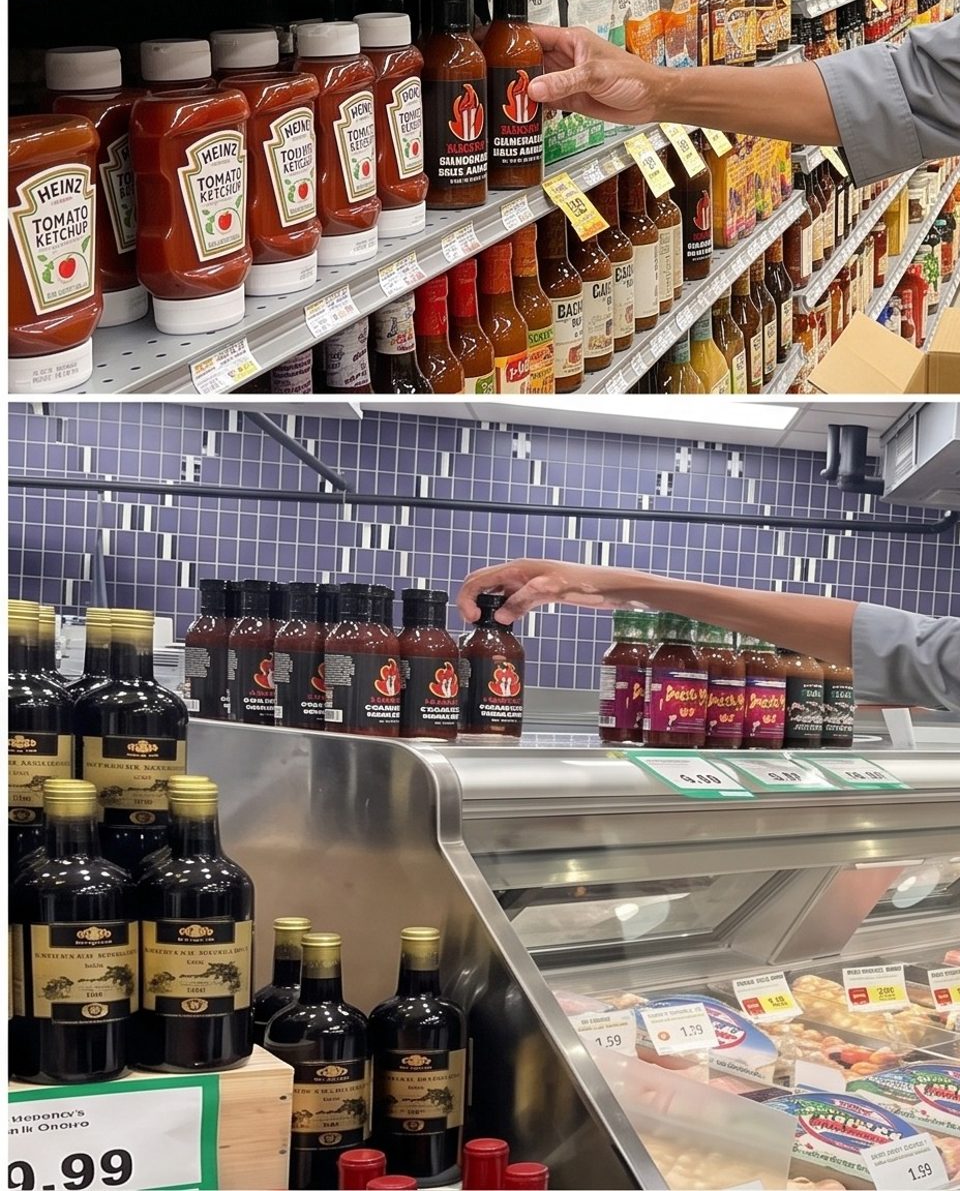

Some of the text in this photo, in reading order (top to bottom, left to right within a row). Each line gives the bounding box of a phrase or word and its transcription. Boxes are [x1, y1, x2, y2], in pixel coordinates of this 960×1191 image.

[37, 178, 82, 204] HEINZ
[197, 167, 241, 191] TOMATO
[32, 205, 88, 235] TOMATO
[36, 220, 88, 248] KETCHUP
[8, 1148, 134, 1191] 9.99
